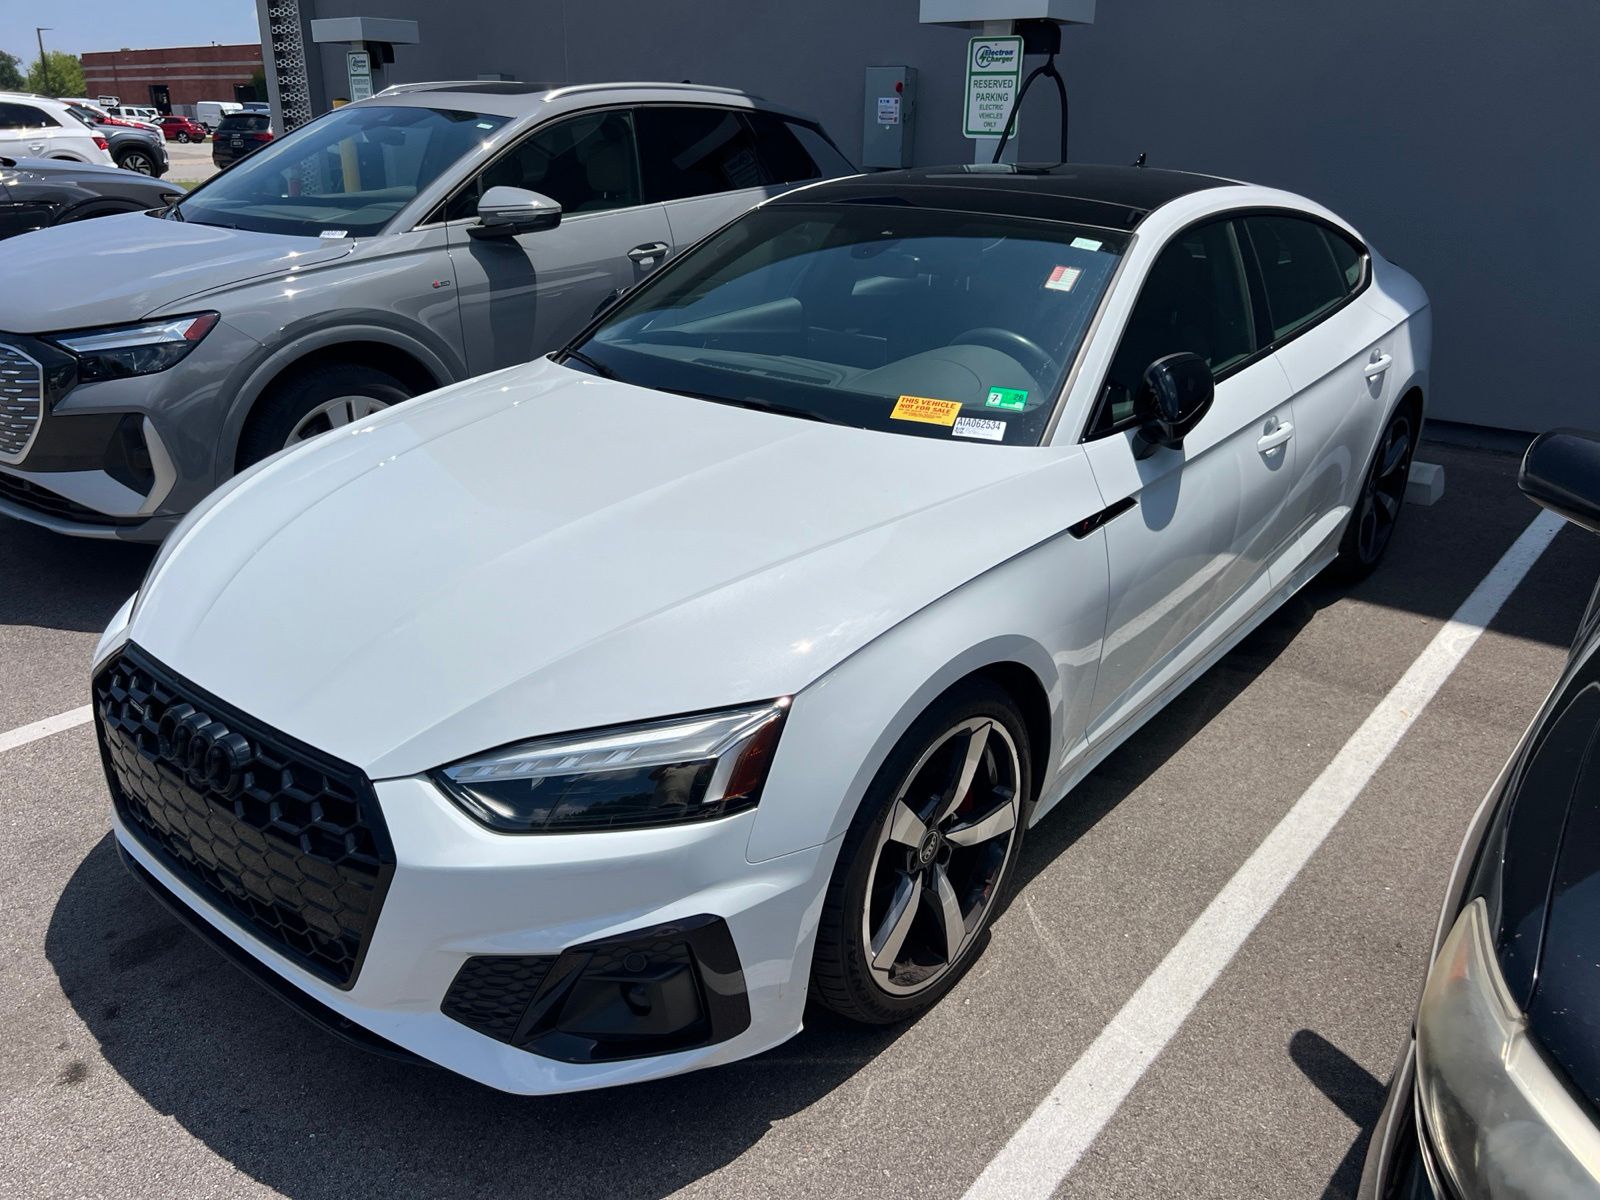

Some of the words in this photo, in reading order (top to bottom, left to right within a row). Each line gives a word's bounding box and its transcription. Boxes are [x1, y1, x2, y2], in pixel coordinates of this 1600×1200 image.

[986, 56, 1014, 64] Charger
[973, 79, 1014, 89] RESERVED
[976, 92, 1009, 102] PARKING
[978, 112, 1003, 120] VEHICLES
[900, 397, 919, 405] THIS
[921, 399, 957, 409] VEHICLE
[992, 393, 999, 403] 7
[933, 407, 952, 415] SALE
